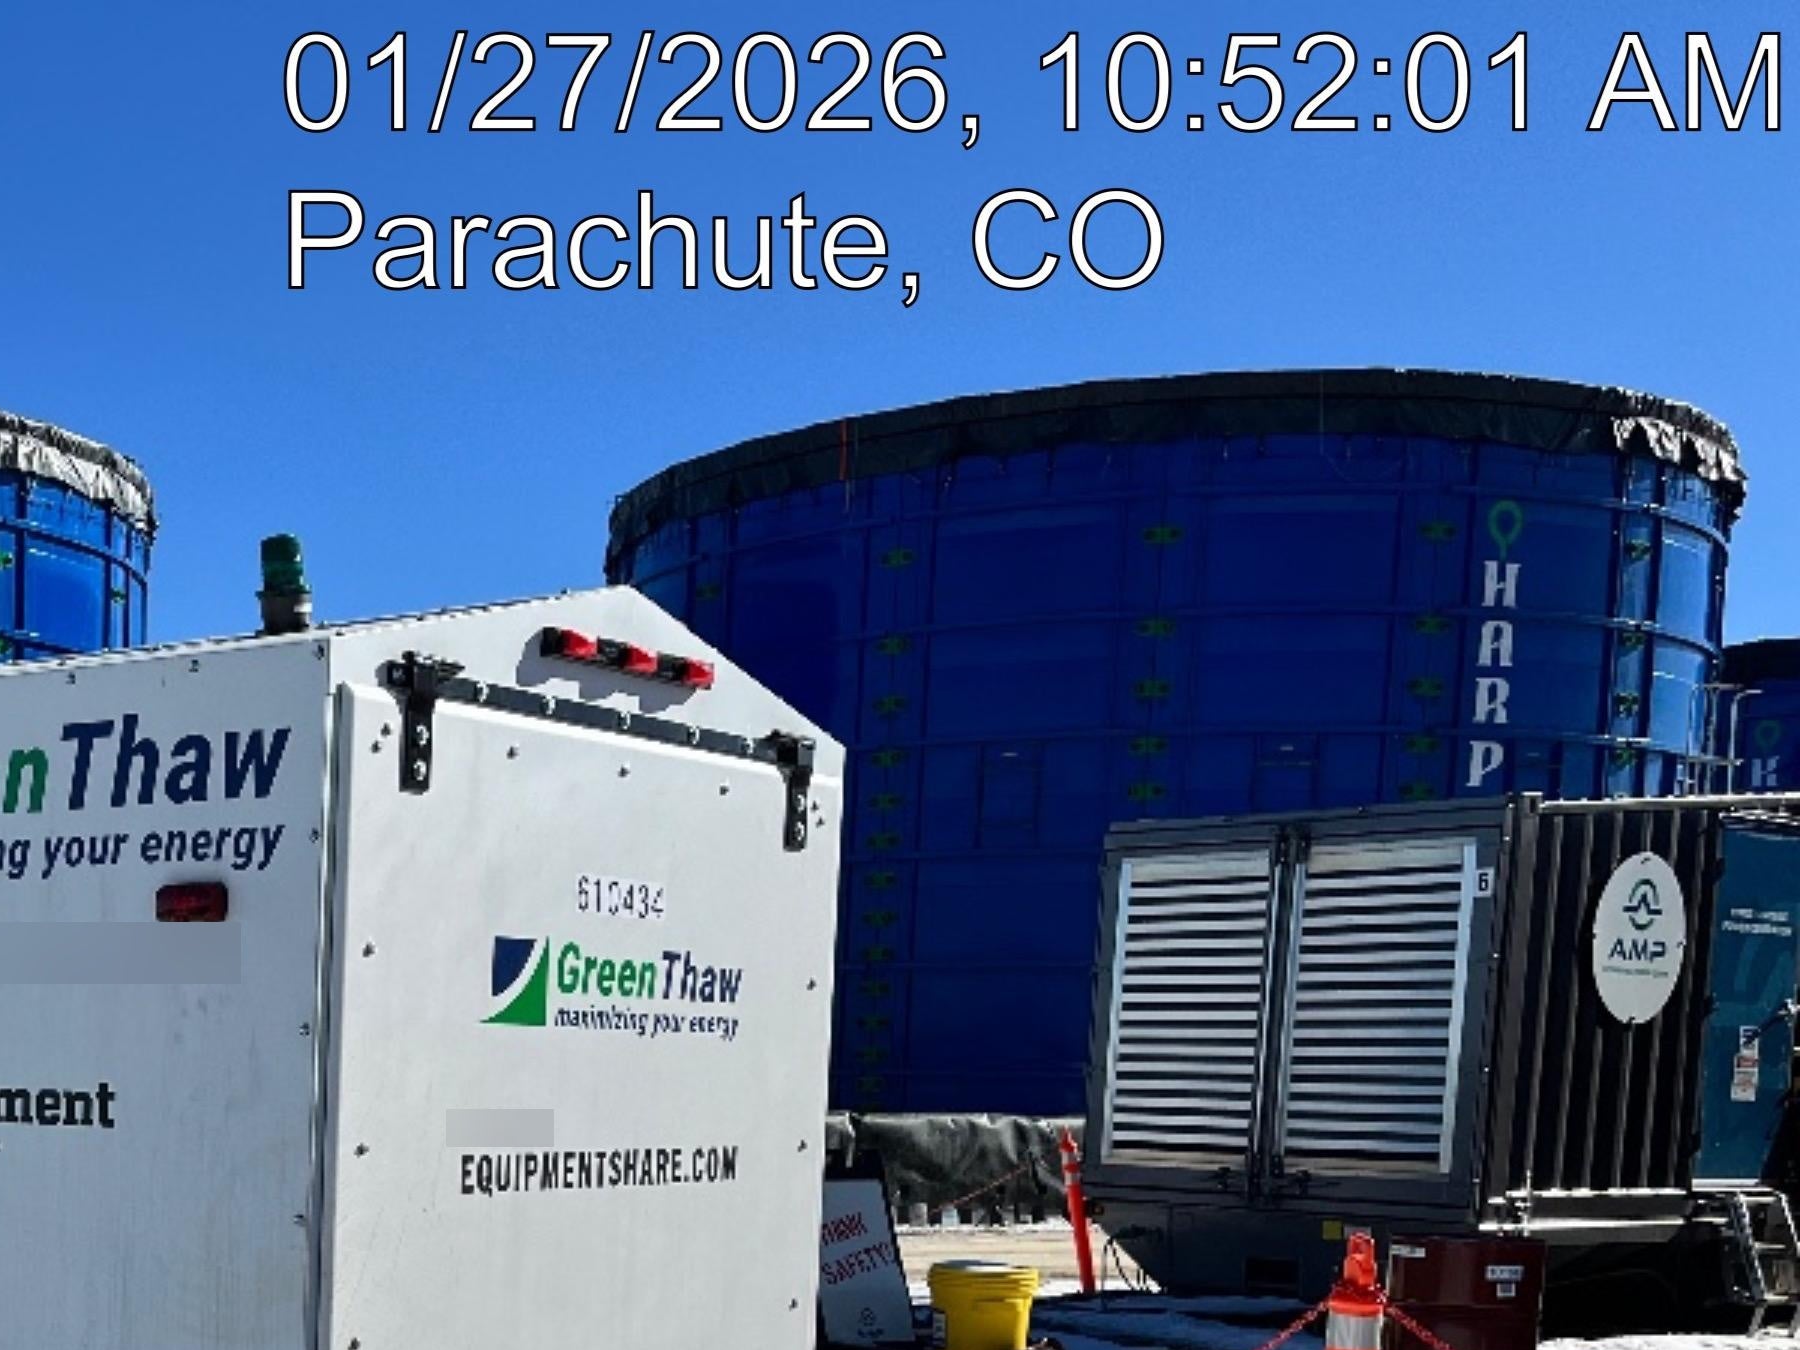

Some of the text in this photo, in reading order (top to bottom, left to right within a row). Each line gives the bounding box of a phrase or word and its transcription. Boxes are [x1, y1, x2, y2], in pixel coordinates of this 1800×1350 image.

[1465, 559, 1522, 787] HARP
[41, 832, 130, 880] your
[139, 823, 287, 872] energy
[577, 875, 664, 919] 610434
[1479, 872, 1489, 891] 6
[1608, 937, 1666, 962] AMP
[460, 1145, 739, 1195] EQUIPMENTSHARE.COM
